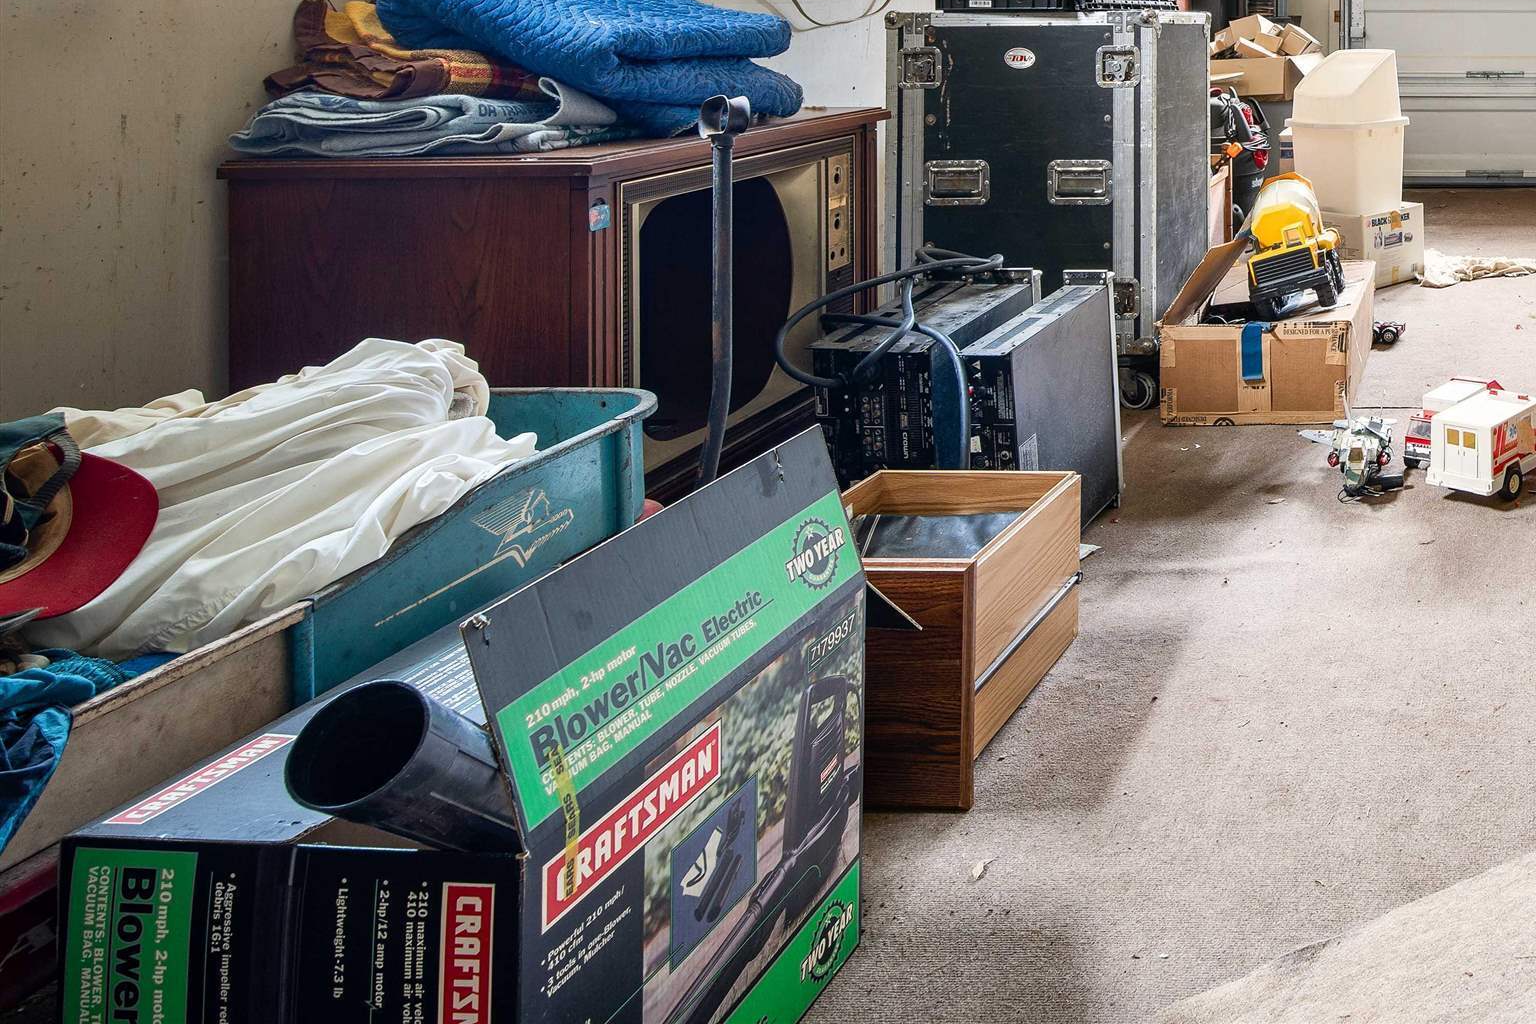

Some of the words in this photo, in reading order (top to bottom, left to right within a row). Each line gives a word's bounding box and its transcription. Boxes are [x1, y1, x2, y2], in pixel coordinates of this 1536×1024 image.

[1371, 217, 1388, 227] BLACK
[786, 551, 815, 582] TWO
[813, 527, 845, 560] YEAR
[810, 613, 856, 661] 7179937
[525, 701, 551, 728] 210
[551, 687, 580, 712] mph,
[580, 667, 605, 689] 2-hp
[607, 645, 637, 671] motor
[529, 633, 697, 769] Blower/Vac
[701, 591, 763, 643] Electric
[598, 709, 639, 742] BLOWER,
[639, 688, 665, 711] TUBE,
[665, 663, 699, 691] NOZZLE,
[698, 637, 731, 666] VACUUM
[590, 741, 613, 763] BAG,
[614, 709, 652, 744] MANUAL
[125, 738, 282, 819] CRAFTSMAN
[84, 866, 99, 926] VACUUM
[95, 866, 111, 943] CONTENTS:
[160, 869, 175, 902] 210
[213, 882, 224, 920] debris
[406, 890, 418, 918] 410
[417, 891, 430, 918] 210
[156, 905, 169, 943] mph,
[222, 883, 237, 951] Aggressive
[376, 889, 390, 940] 2-hp/12
[547, 922, 585, 962] Powerful
[586, 904, 604, 927] 210
[82, 930, 93, 962] BAG,
[210, 924, 222, 954] 16:1
[375, 943, 387, 969] amp
[404, 921, 414, 980] maximum
[415, 921, 427, 980] maximum
[547, 950, 566, 971] 410
[567, 935, 584, 957] cfm
[801, 939, 826, 982] TWO
[827, 902, 854, 946] YEAR
[91, 947, 104, 1010] BLOWER,
[152, 950, 168, 985] 2-hp
[219, 954, 232, 1002] impeller
[546, 963, 582, 998] Vacuum,
[583, 929, 616, 965] Mulcher
[547, 977, 555, 988] 3
[556, 957, 576, 980] tools
[578, 947, 586, 959] in
[333, 987, 344, 998] lb
[374, 973, 385, 1008] motor
[403, 983, 413, 999] air
[415, 982, 425, 1000] air
